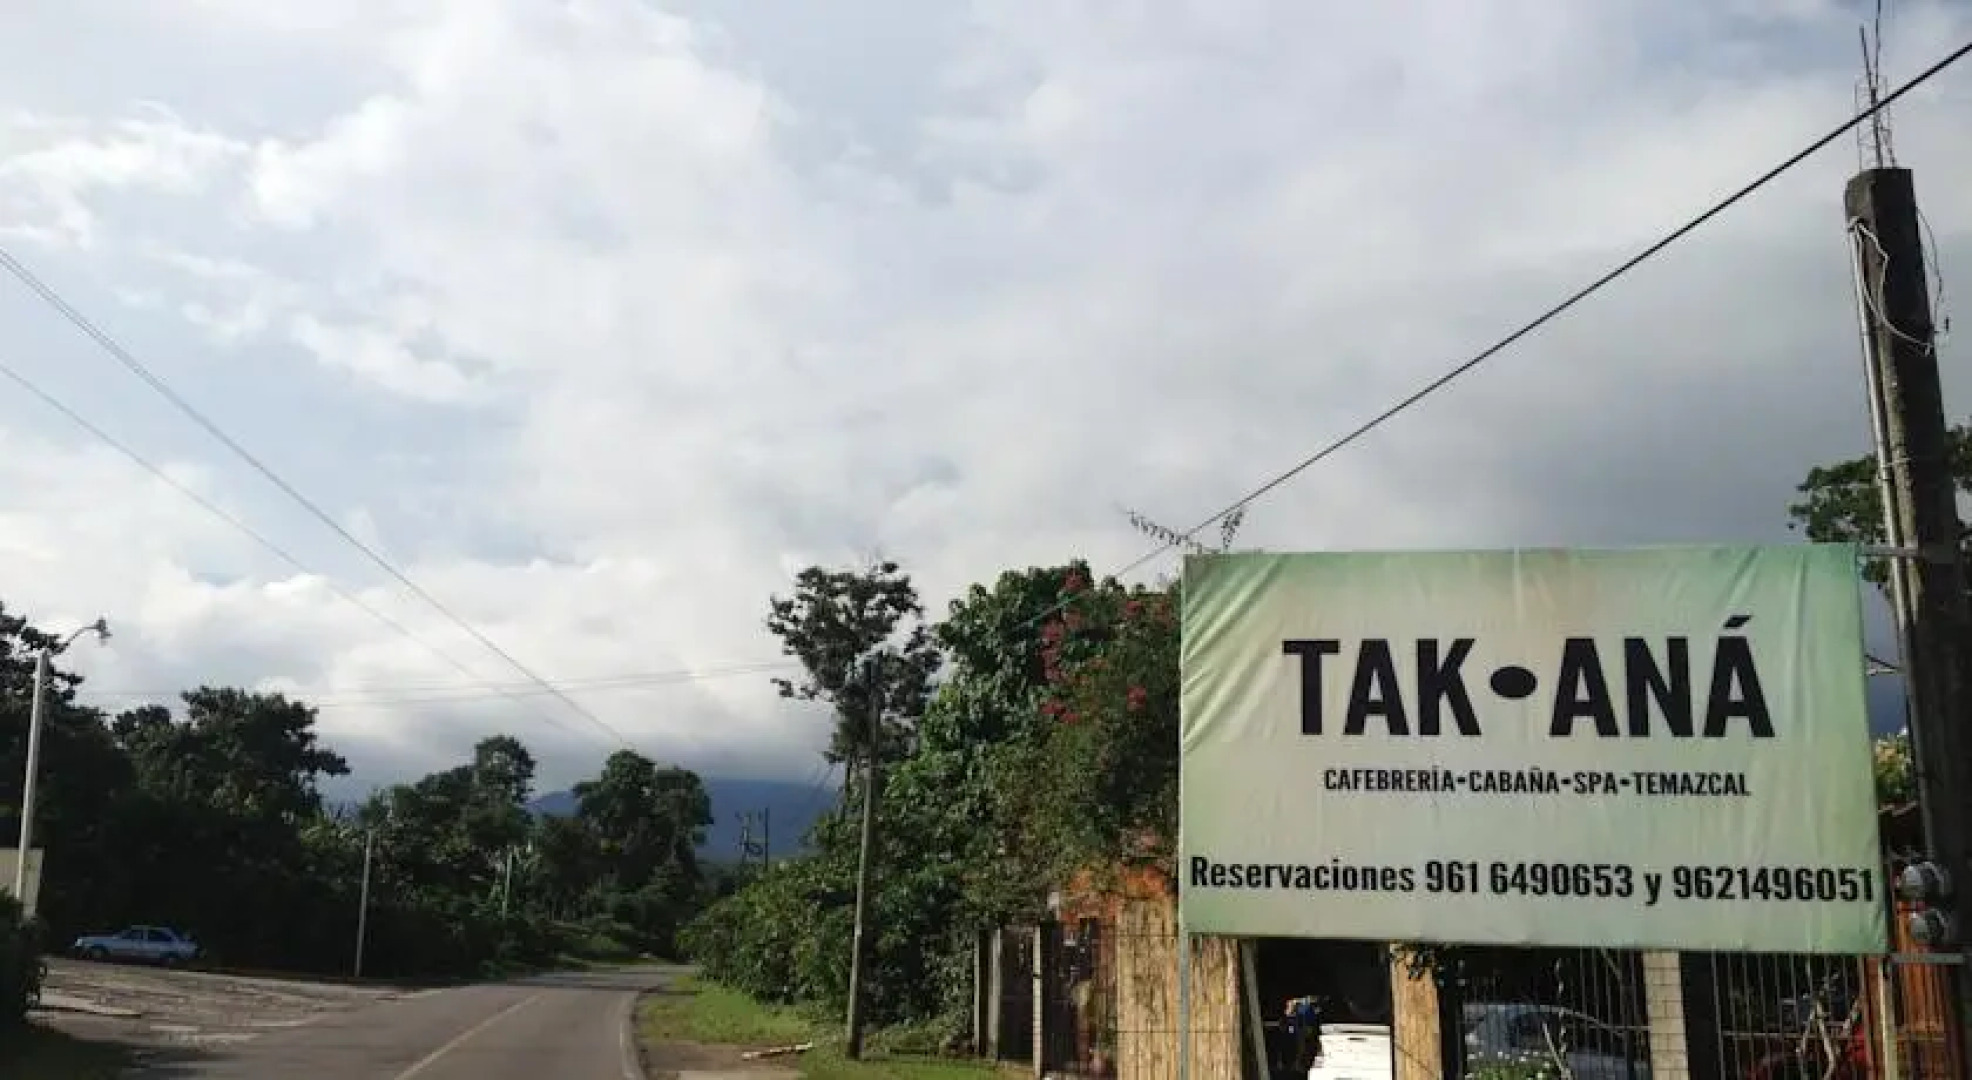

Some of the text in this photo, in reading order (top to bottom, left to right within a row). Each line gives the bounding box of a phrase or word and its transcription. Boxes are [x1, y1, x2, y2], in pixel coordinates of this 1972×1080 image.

[1190, 856, 1875, 907] Reservaciones 961 6490653 y 9621496051
